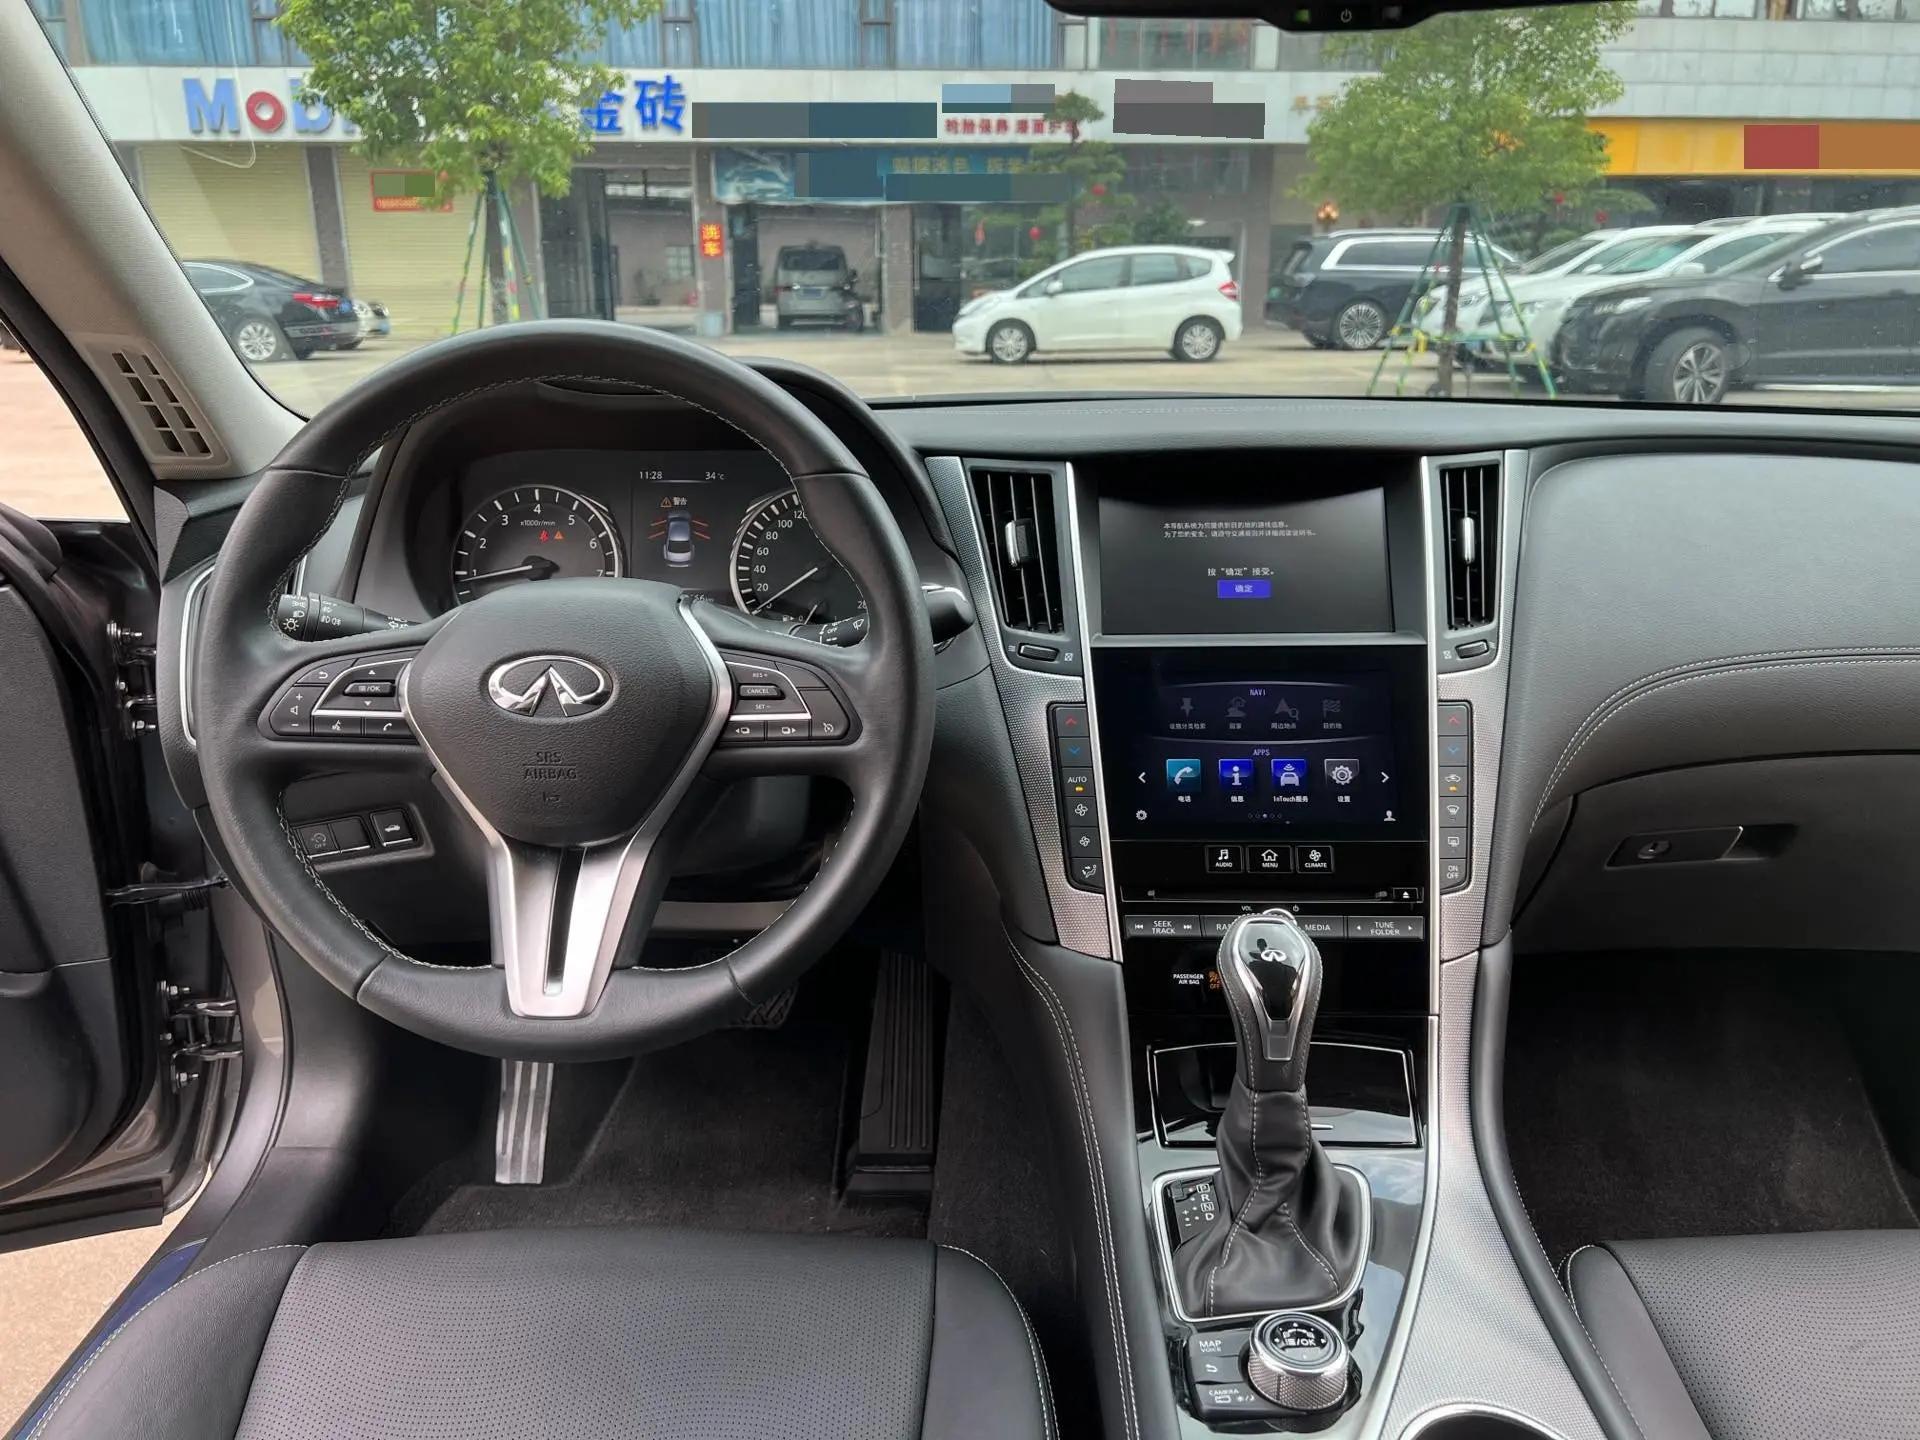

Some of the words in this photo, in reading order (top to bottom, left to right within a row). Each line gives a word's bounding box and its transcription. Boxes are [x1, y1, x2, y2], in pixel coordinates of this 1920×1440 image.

[579, 75, 685, 134] 金砖
[640, 471, 663, 480] 11:28
[534, 503, 541, 514] 4
[502, 515, 509, 526] 3
[568, 515, 575, 526] 5
[777, 519, 793, 528] 100
[765, 531, 778, 540] 80
[479, 537, 487, 549] 2
[589, 537, 597, 549] 6
[756, 547, 769, 556] 60
[753, 565, 766, 574] 40
[756, 583, 769, 592] 20
[1235, 584, 1253, 593] 确定
[535, 751, 563, 764] SRS
[523, 767, 578, 780] AIRBAG
[1067, 775, 1088, 783] AUTO
[1177, 795, 1192, 803] 电话
[1230, 795, 1245, 803] 信息
[1337, 795, 1351, 803] 设置
[1448, 864, 1459, 872] ON
[1446, 871, 1459, 880] OFF
[1370, 928, 1400, 936] FOLDER
[1205, 1212, 1214, 1221] D
[1199, 1340, 1222, 1348] MAP
[1209, 1388, 1239, 1396] CAMERA
